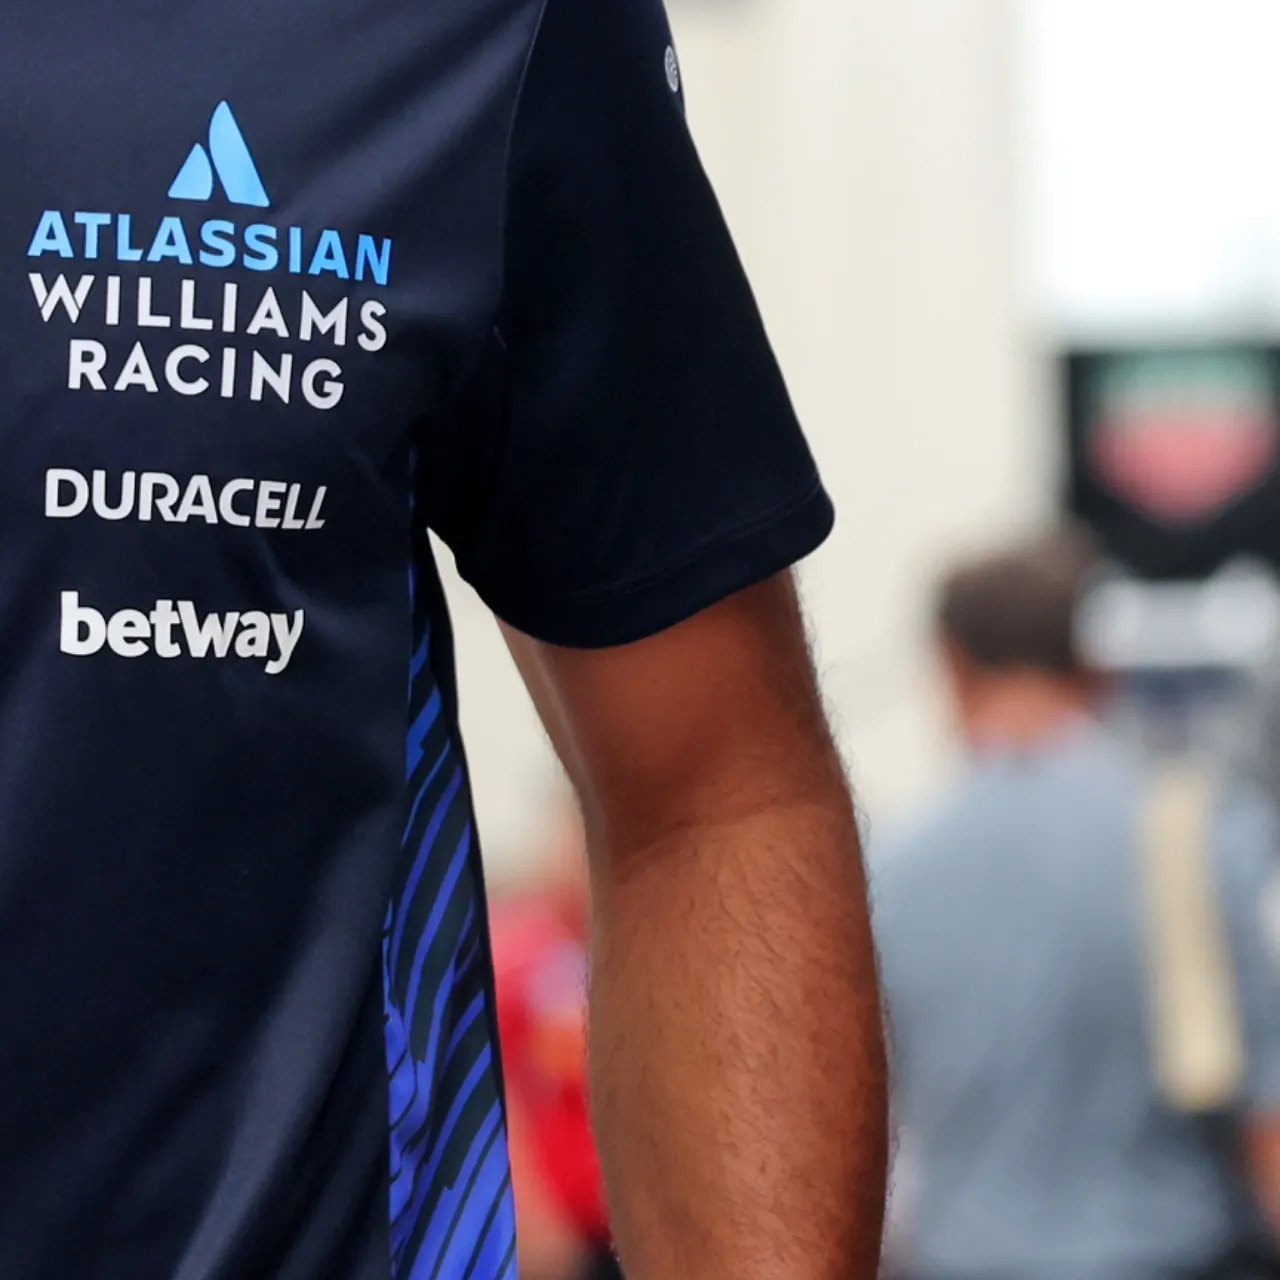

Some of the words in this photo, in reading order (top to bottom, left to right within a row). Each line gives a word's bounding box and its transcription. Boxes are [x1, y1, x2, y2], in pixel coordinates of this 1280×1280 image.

[27, 209, 392, 286] ATLASSIAN
[27, 272, 389, 352] WILLIAMS
[67, 338, 345, 410] RACING
[45, 468, 328, 529] DURACELL
[60, 590, 304, 675] betway
